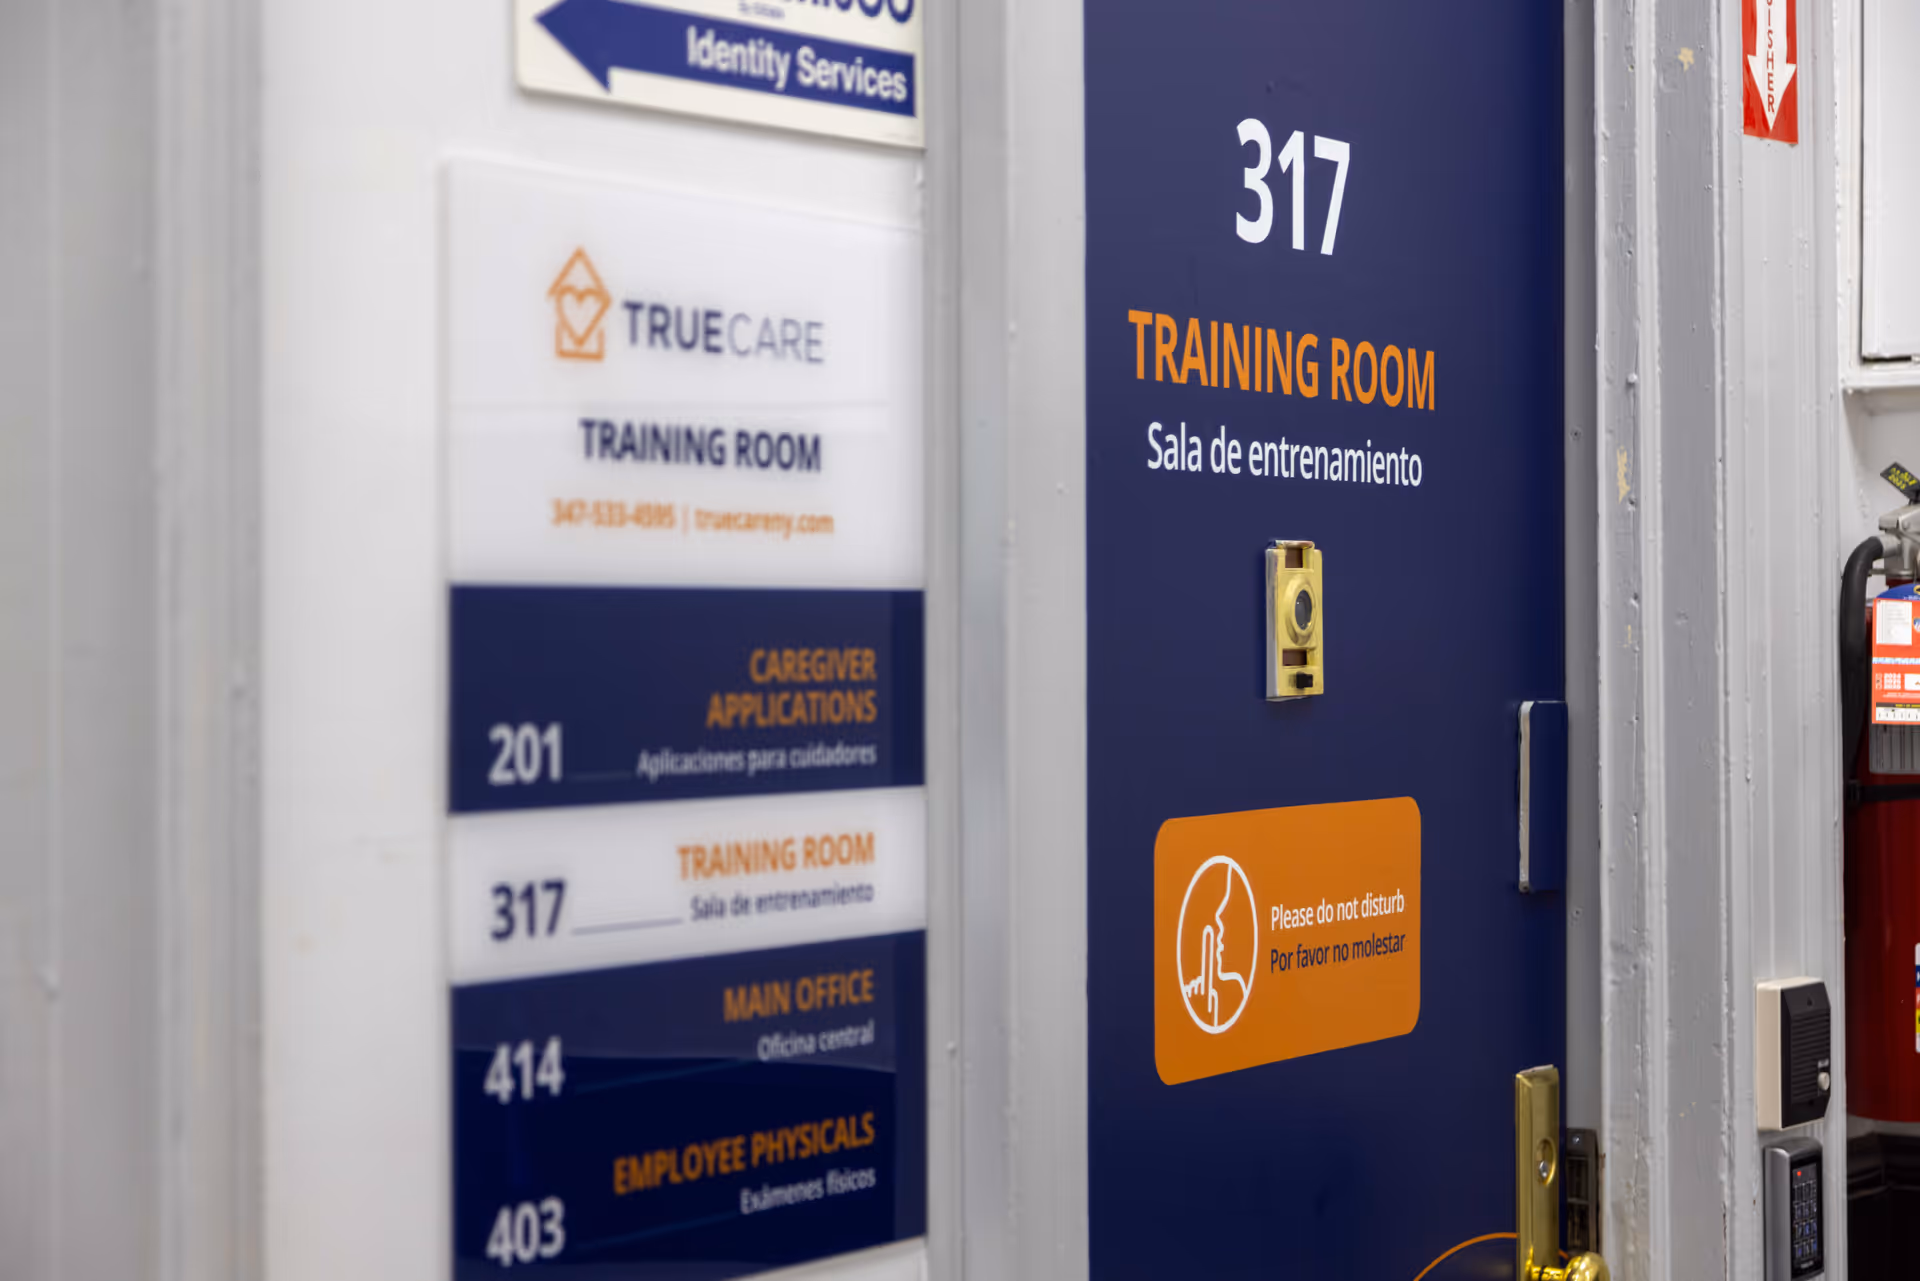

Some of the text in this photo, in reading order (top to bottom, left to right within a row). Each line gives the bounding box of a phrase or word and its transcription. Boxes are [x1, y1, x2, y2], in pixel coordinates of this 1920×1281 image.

[687, 25, 907, 102] Identity Services
[1236, 118, 1350, 255] 317
[622, 299, 825, 364] TRUECARE
[1128, 309, 1435, 411] TRAINING ROOM
[579, 417, 822, 473] TRAINING ROOM
[1147, 421, 1423, 487] Sala de entrenamiento
[695, 507, 834, 541] truecareny.com
[750, 648, 877, 683] CAREGIVER
[706, 689, 877, 728] APPLICATIONS
[487, 722, 563, 785] 201
[637, 742, 877, 782] Aplicaciones para cuidadores
[677, 832, 875, 880] TRAINING ROOM
[491, 878, 568, 941] 317
[690, 881, 875, 922] Sala de entrenamiento
[1271, 888, 1404, 931] Please do not disturb
[1271, 932, 1406, 974] Por favor no molestar
[724, 969, 875, 1023] MAIN OFFICE
[758, 1019, 874, 1062] Oficina central
[484, 1036, 565, 1104] 414
[613, 1112, 875, 1195] EMPLOYEE PHYSICALS
[740, 1167, 876, 1215] Exámenes físicos
[486, 1196, 566, 1267] 403
